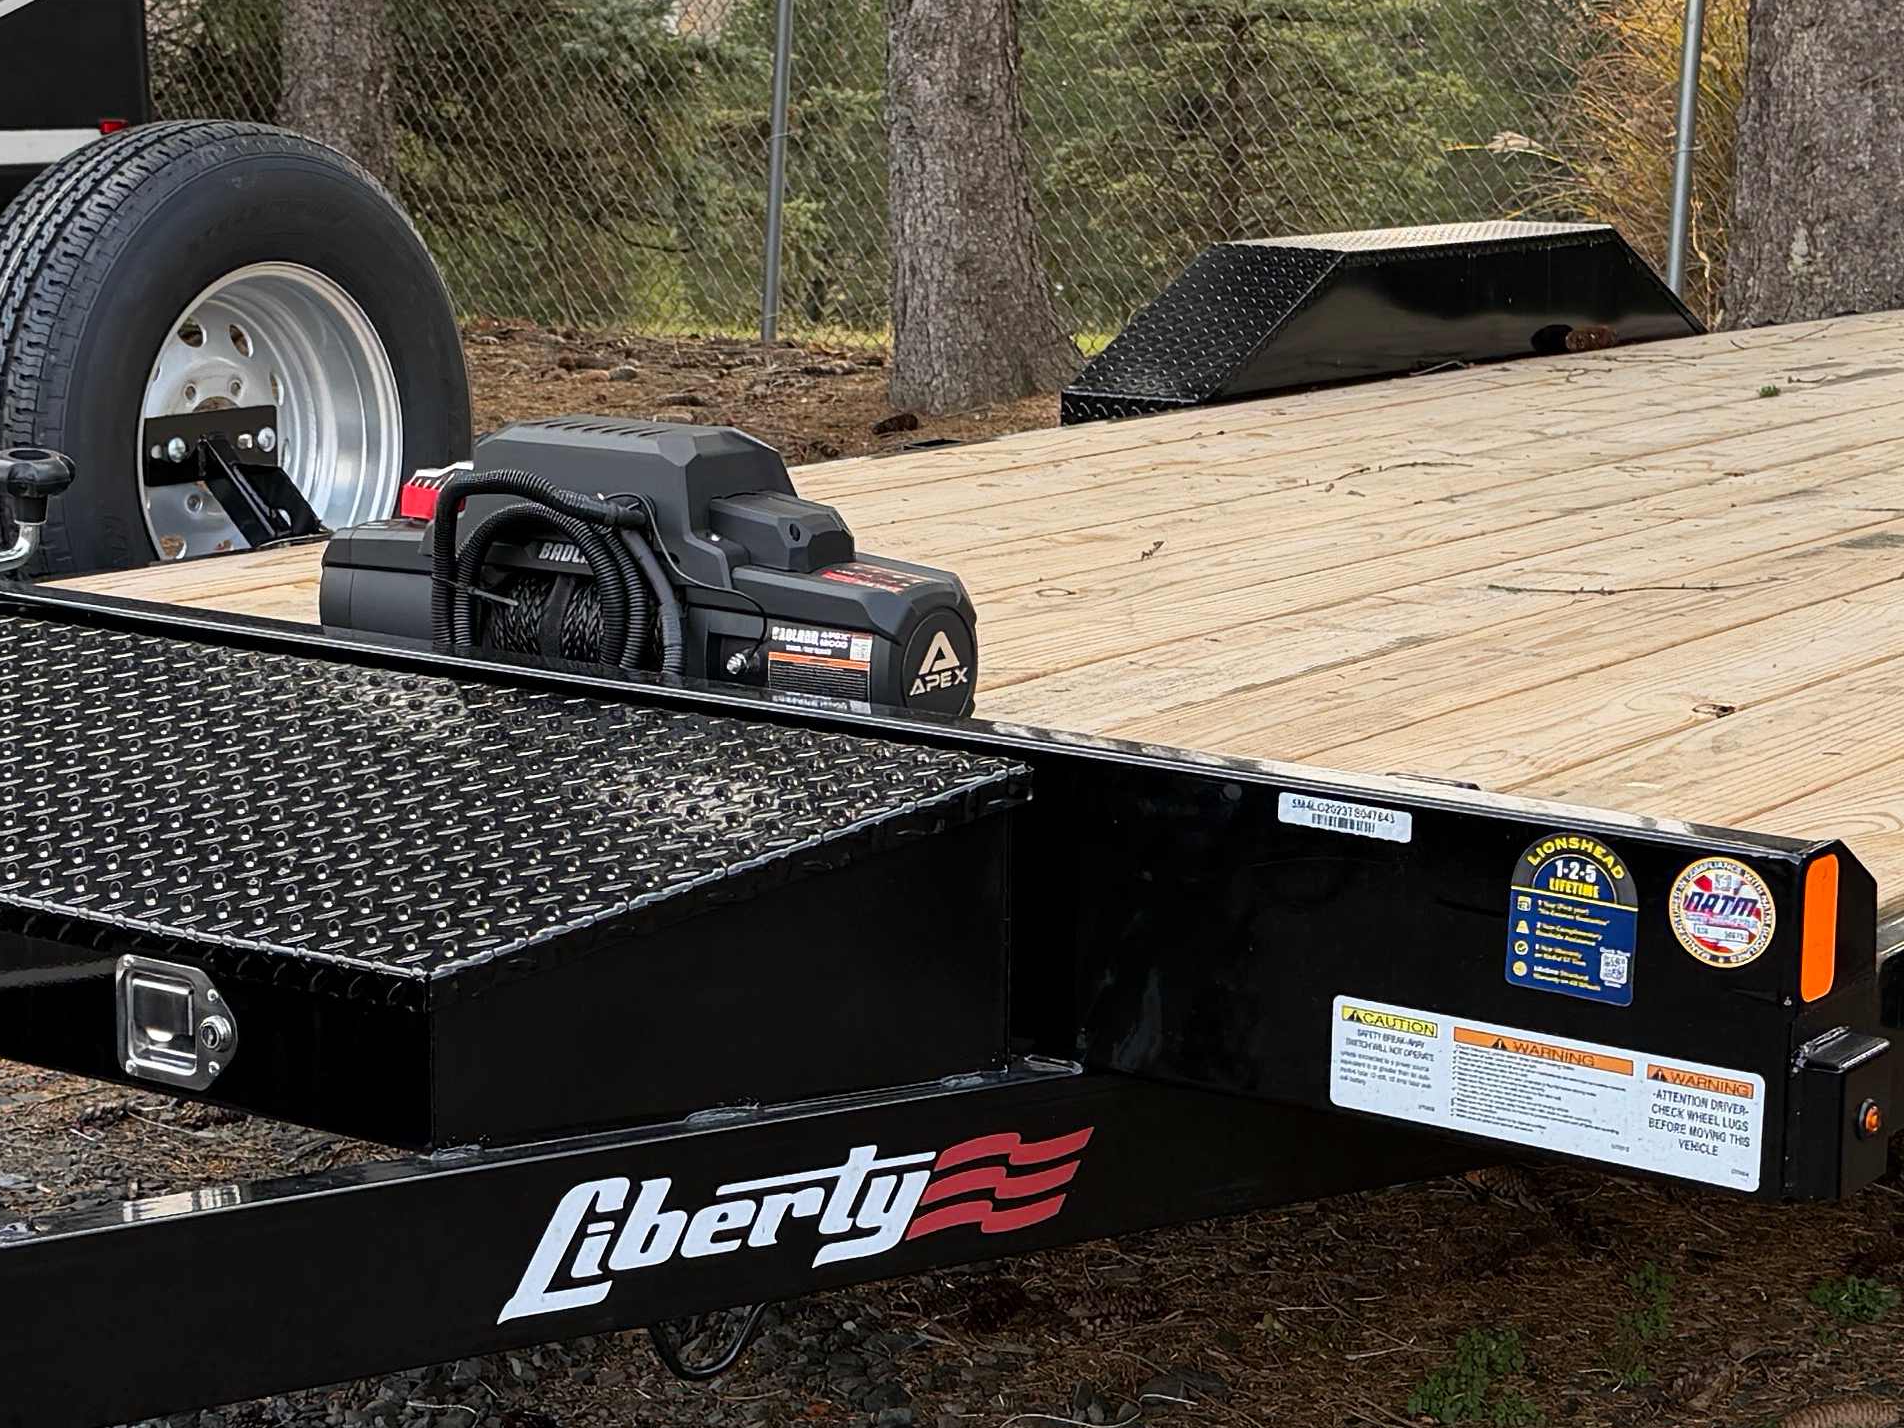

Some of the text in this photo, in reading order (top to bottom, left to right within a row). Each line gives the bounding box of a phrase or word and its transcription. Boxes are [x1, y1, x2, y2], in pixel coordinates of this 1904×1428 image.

[538, 542, 589, 564] BADL
[909, 666, 969, 697] APEX
[1526, 836, 1626, 880] LIONSHEAD
[1549, 877, 1600, 899] LIFETIME
[1362, 1012, 1435, 1036] CAUTION
[1511, 1041, 1596, 1067] WARNING
[1670, 1073, 1750, 1096] WARNING
[1651, 1103, 1749, 1132] CHECK WHEEL LUGS
[1648, 1117, 1751, 1148] BEFORE MOVING THIS
[1678, 1138, 1719, 1157] VEHICLE
[497, 1144, 936, 1325] Liberty
